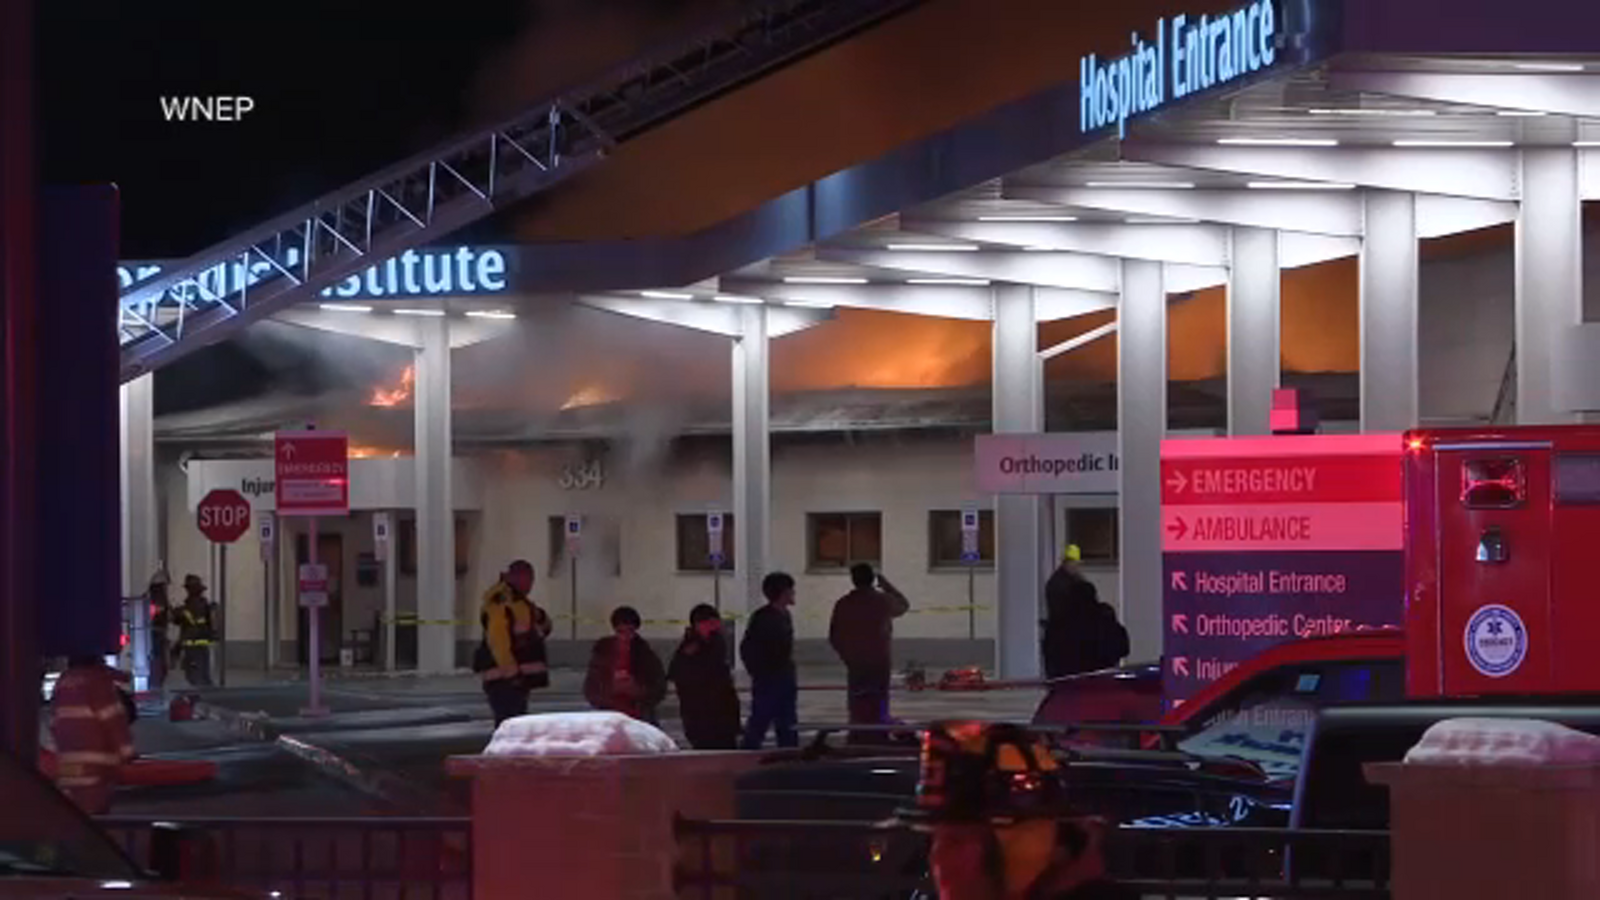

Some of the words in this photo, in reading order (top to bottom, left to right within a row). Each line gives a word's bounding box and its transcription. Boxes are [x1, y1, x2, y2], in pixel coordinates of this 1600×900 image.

[1080, 17, 1164, 140] Hospital
[1172, 0, 1274, 99] Entrance
[560, 460, 604, 489] 334
[1000, 453, 1104, 475] Orthopedic
[1192, 468, 1316, 493] EMERGENCY
[201, 506, 248, 526] STOP
[1192, 517, 1311, 541] AMBULANCE
[1195, 571, 1264, 597] Hospital
[1269, 571, 1346, 592] Entrance
[1196, 614, 1289, 640] Orthopedic
